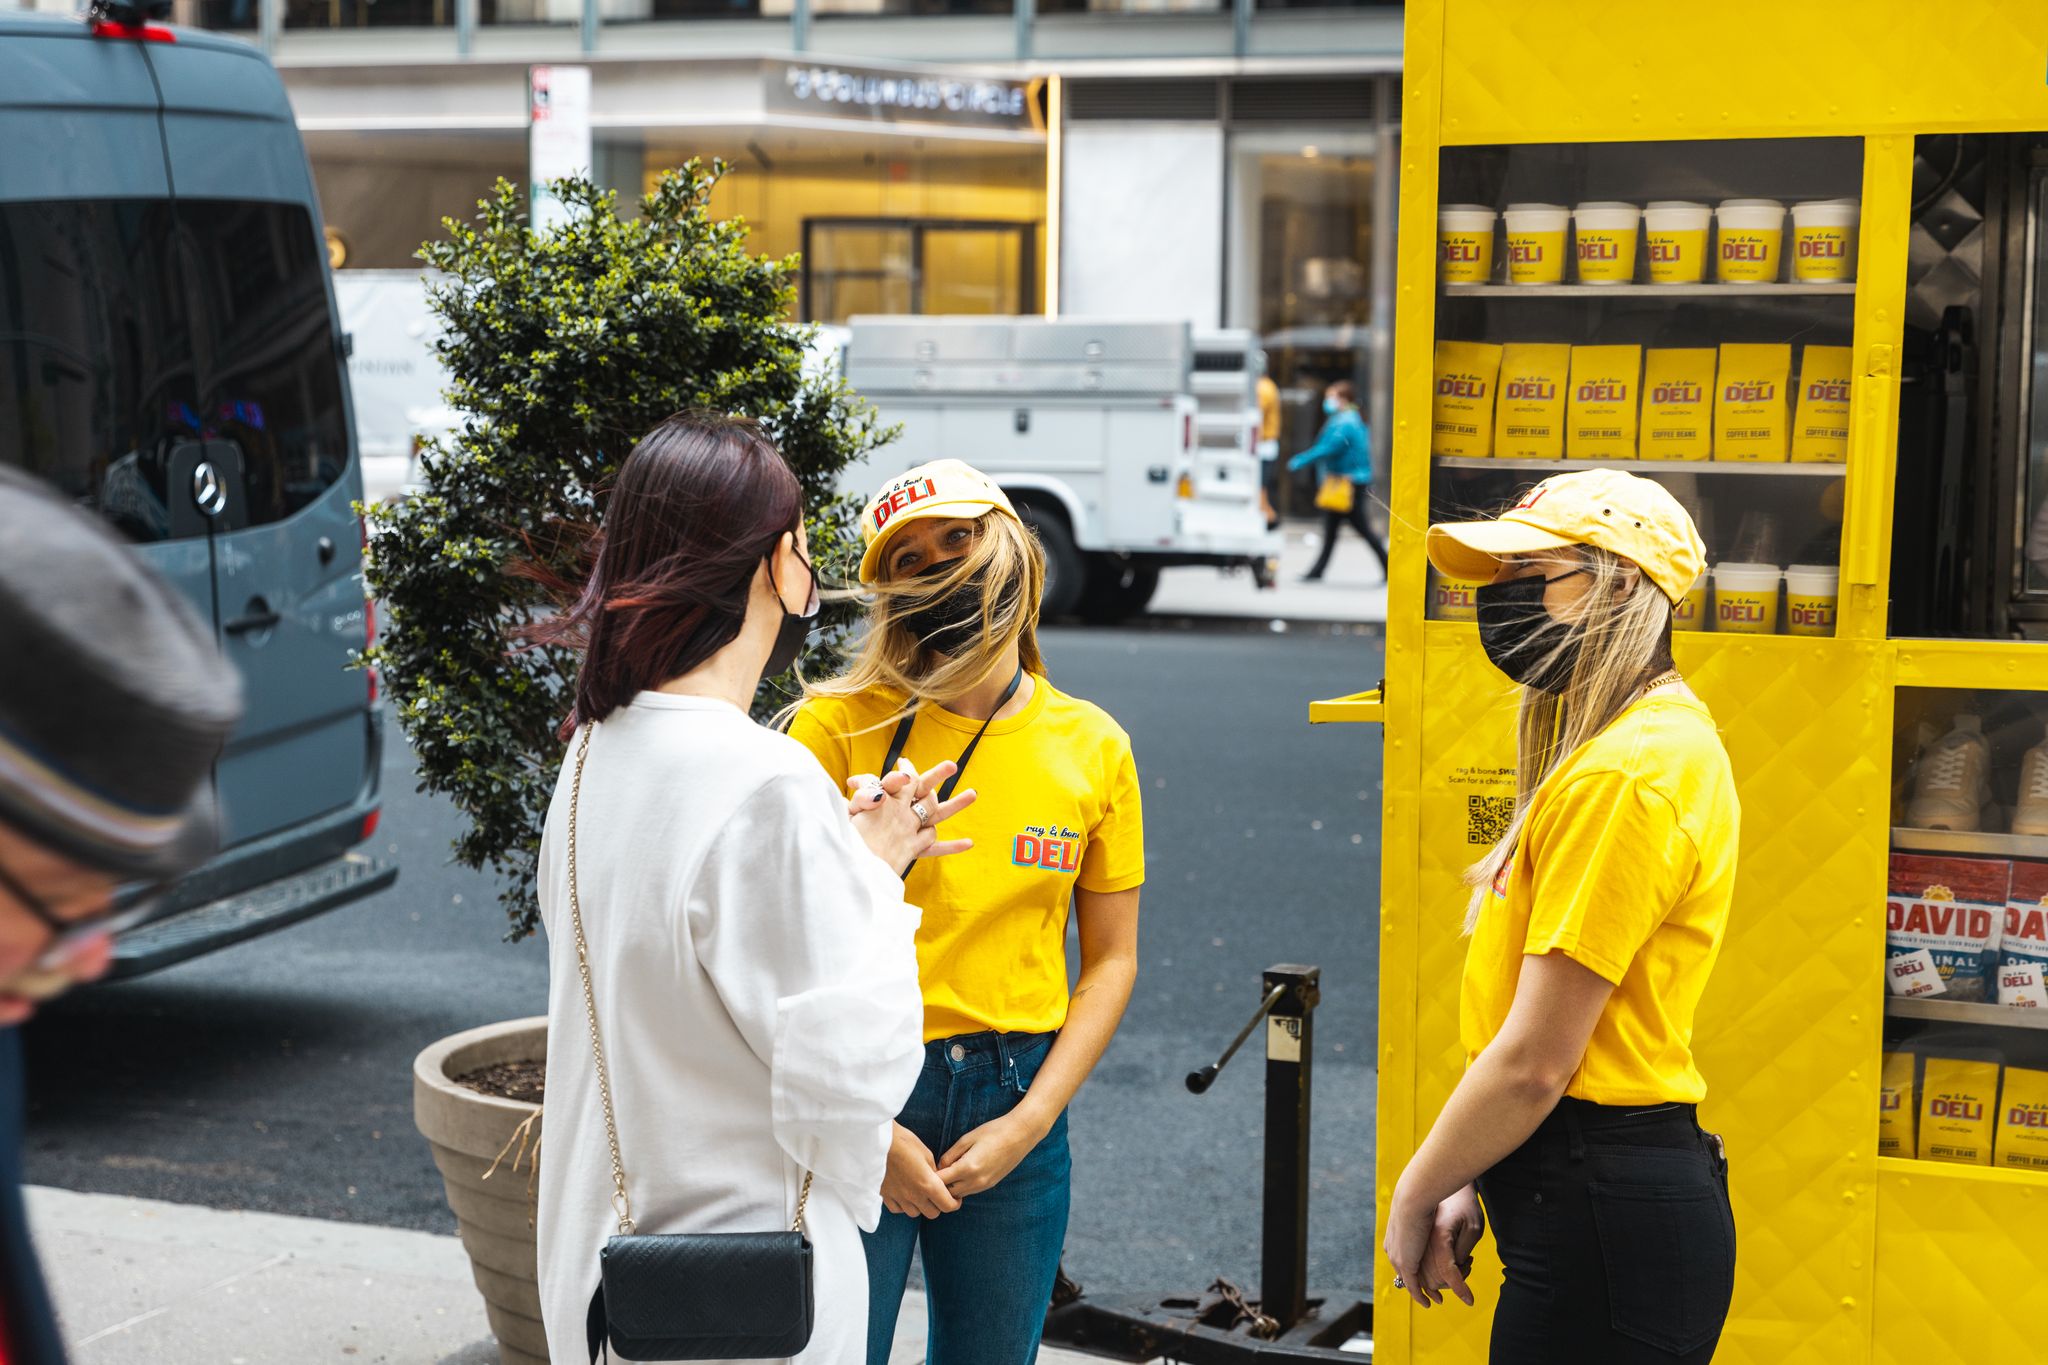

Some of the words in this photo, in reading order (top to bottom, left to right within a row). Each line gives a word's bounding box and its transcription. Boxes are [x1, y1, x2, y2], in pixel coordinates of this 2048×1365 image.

[814, 69, 941, 109] COLUMBUS
[943, 82, 1024, 115] CIRCLE
[1577, 244, 1618, 261] DELI
[1722, 243, 1767, 261] DELI
[1799, 240, 1845, 259] DELI
[1437, 378, 1486, 399] DELI
[1506, 383, 1555, 400] DELI
[1577, 385, 1626, 402] DELI
[1651, 386, 1701, 404] DELI
[1724, 385, 1774, 403] DELI
[1807, 384, 1850, 402] DEL
[1435, 423, 1456, 433] COFFEE
[1458, 425, 1477, 434] BEANS
[1506, 427, 1527, 435] COFFEE
[1578, 430, 1599, 438] COFFEE
[1806, 429, 1827, 437] COFFEE
[1831, 430, 1848, 438] BEAN
[873, 479, 936, 533] DELI
[1437, 590, 1476, 608] DEL
[1720, 604, 1765, 622] DELI
[1456, 767, 1469, 775] rag
[1478, 767, 1497, 775] bone
[1498, 768, 1516, 776] SWE
[1486, 778, 1511, 786] chance
[1026, 826, 1045, 837] rag
[1049, 825, 1057, 837] &
[1061, 827, 1080, 839] bon
[1887, 902, 1992, 939] DAVID
[2004, 907, 2048, 942] DA
[1893, 951, 1977, 967] OINAL
[1893, 961, 1924, 977] DELI
[2003, 975, 2032, 988] DELI
[1905, 984, 1934, 997] DAVID
[1930, 1099, 1983, 1121] DELI
[2008, 1108, 2048, 1128] DEL
[1930, 1146, 1953, 1155] COFFEE
[1956, 1148, 1977, 1158] BEANS
[2007, 1155, 2030, 1164] COFFEE
